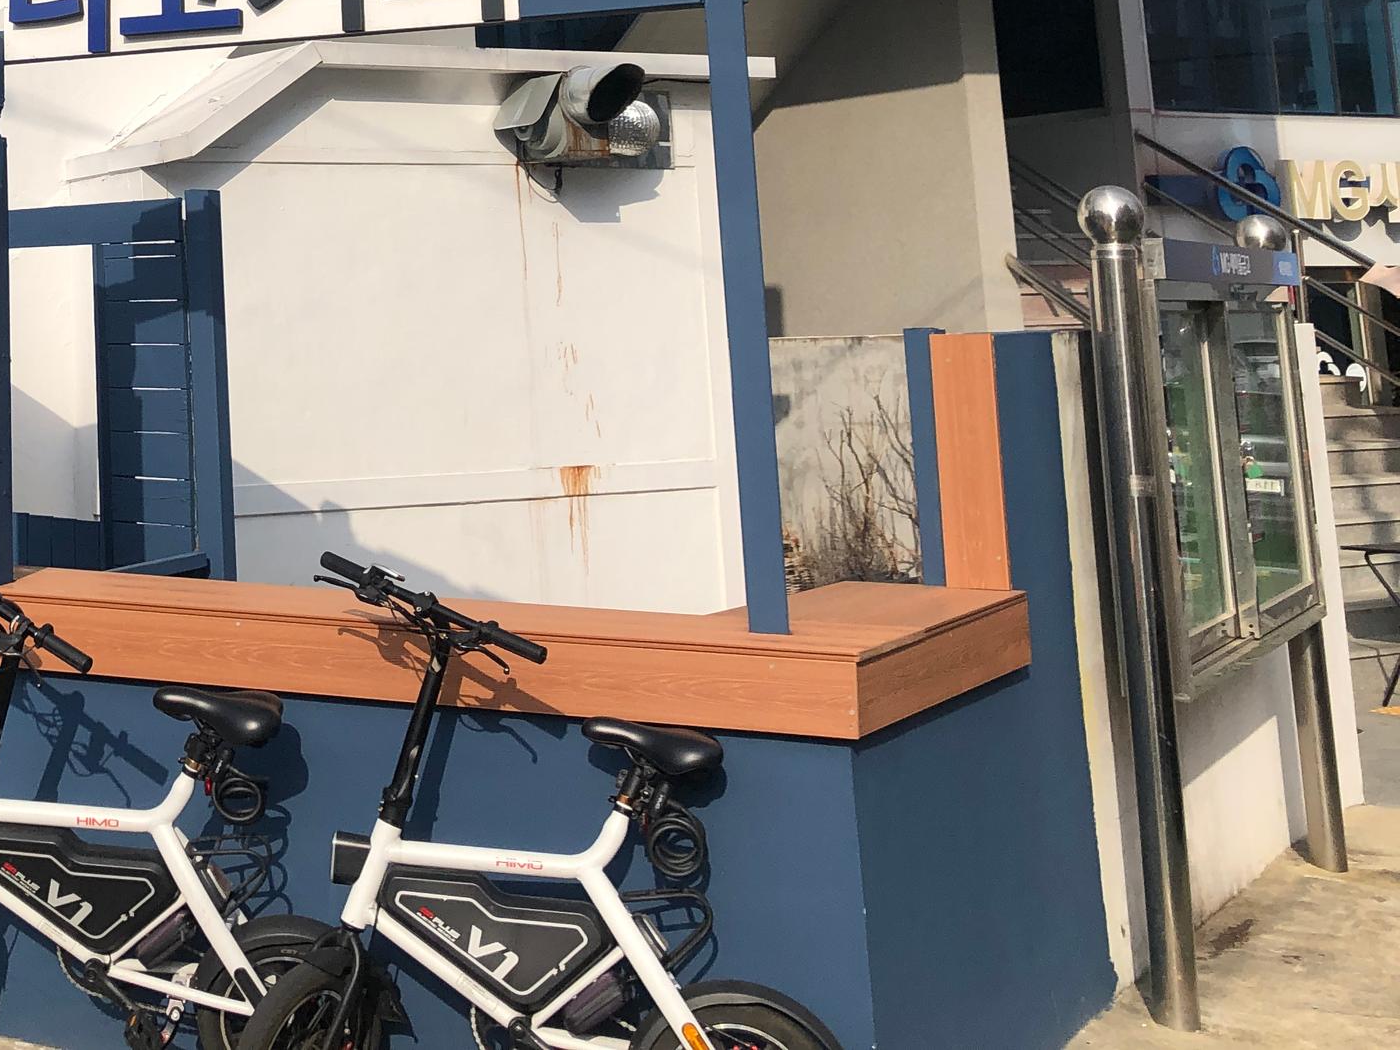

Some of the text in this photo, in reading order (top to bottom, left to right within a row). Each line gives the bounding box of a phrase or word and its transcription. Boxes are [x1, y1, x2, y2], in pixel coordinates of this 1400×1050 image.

[76, 816, 119, 828] HIMO
[47, 877, 93, 926] V1
[467, 924, 520, 981] V1
